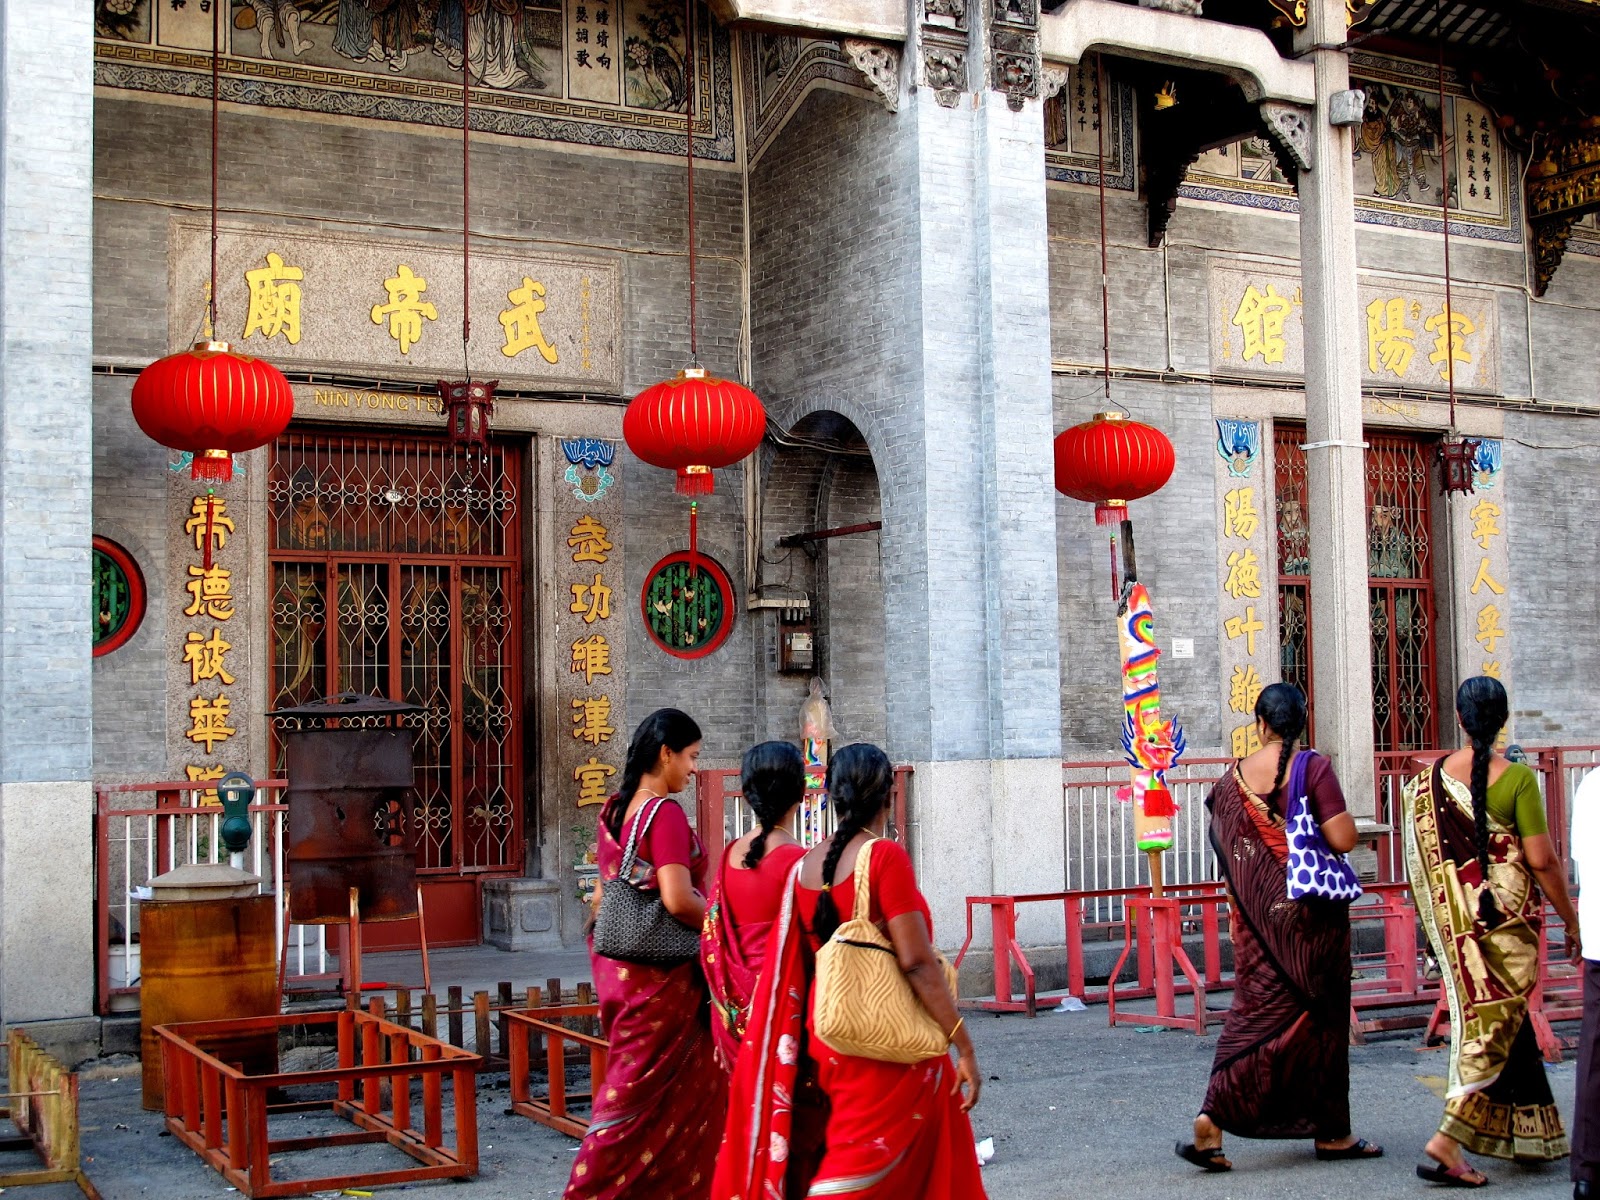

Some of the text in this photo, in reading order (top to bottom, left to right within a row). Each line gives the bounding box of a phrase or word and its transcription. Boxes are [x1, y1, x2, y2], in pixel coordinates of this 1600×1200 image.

[315, 389, 349, 407] NIN
[353, 391, 409, 411] YONG
[1371, 401, 1419, 416] TEMPLE
